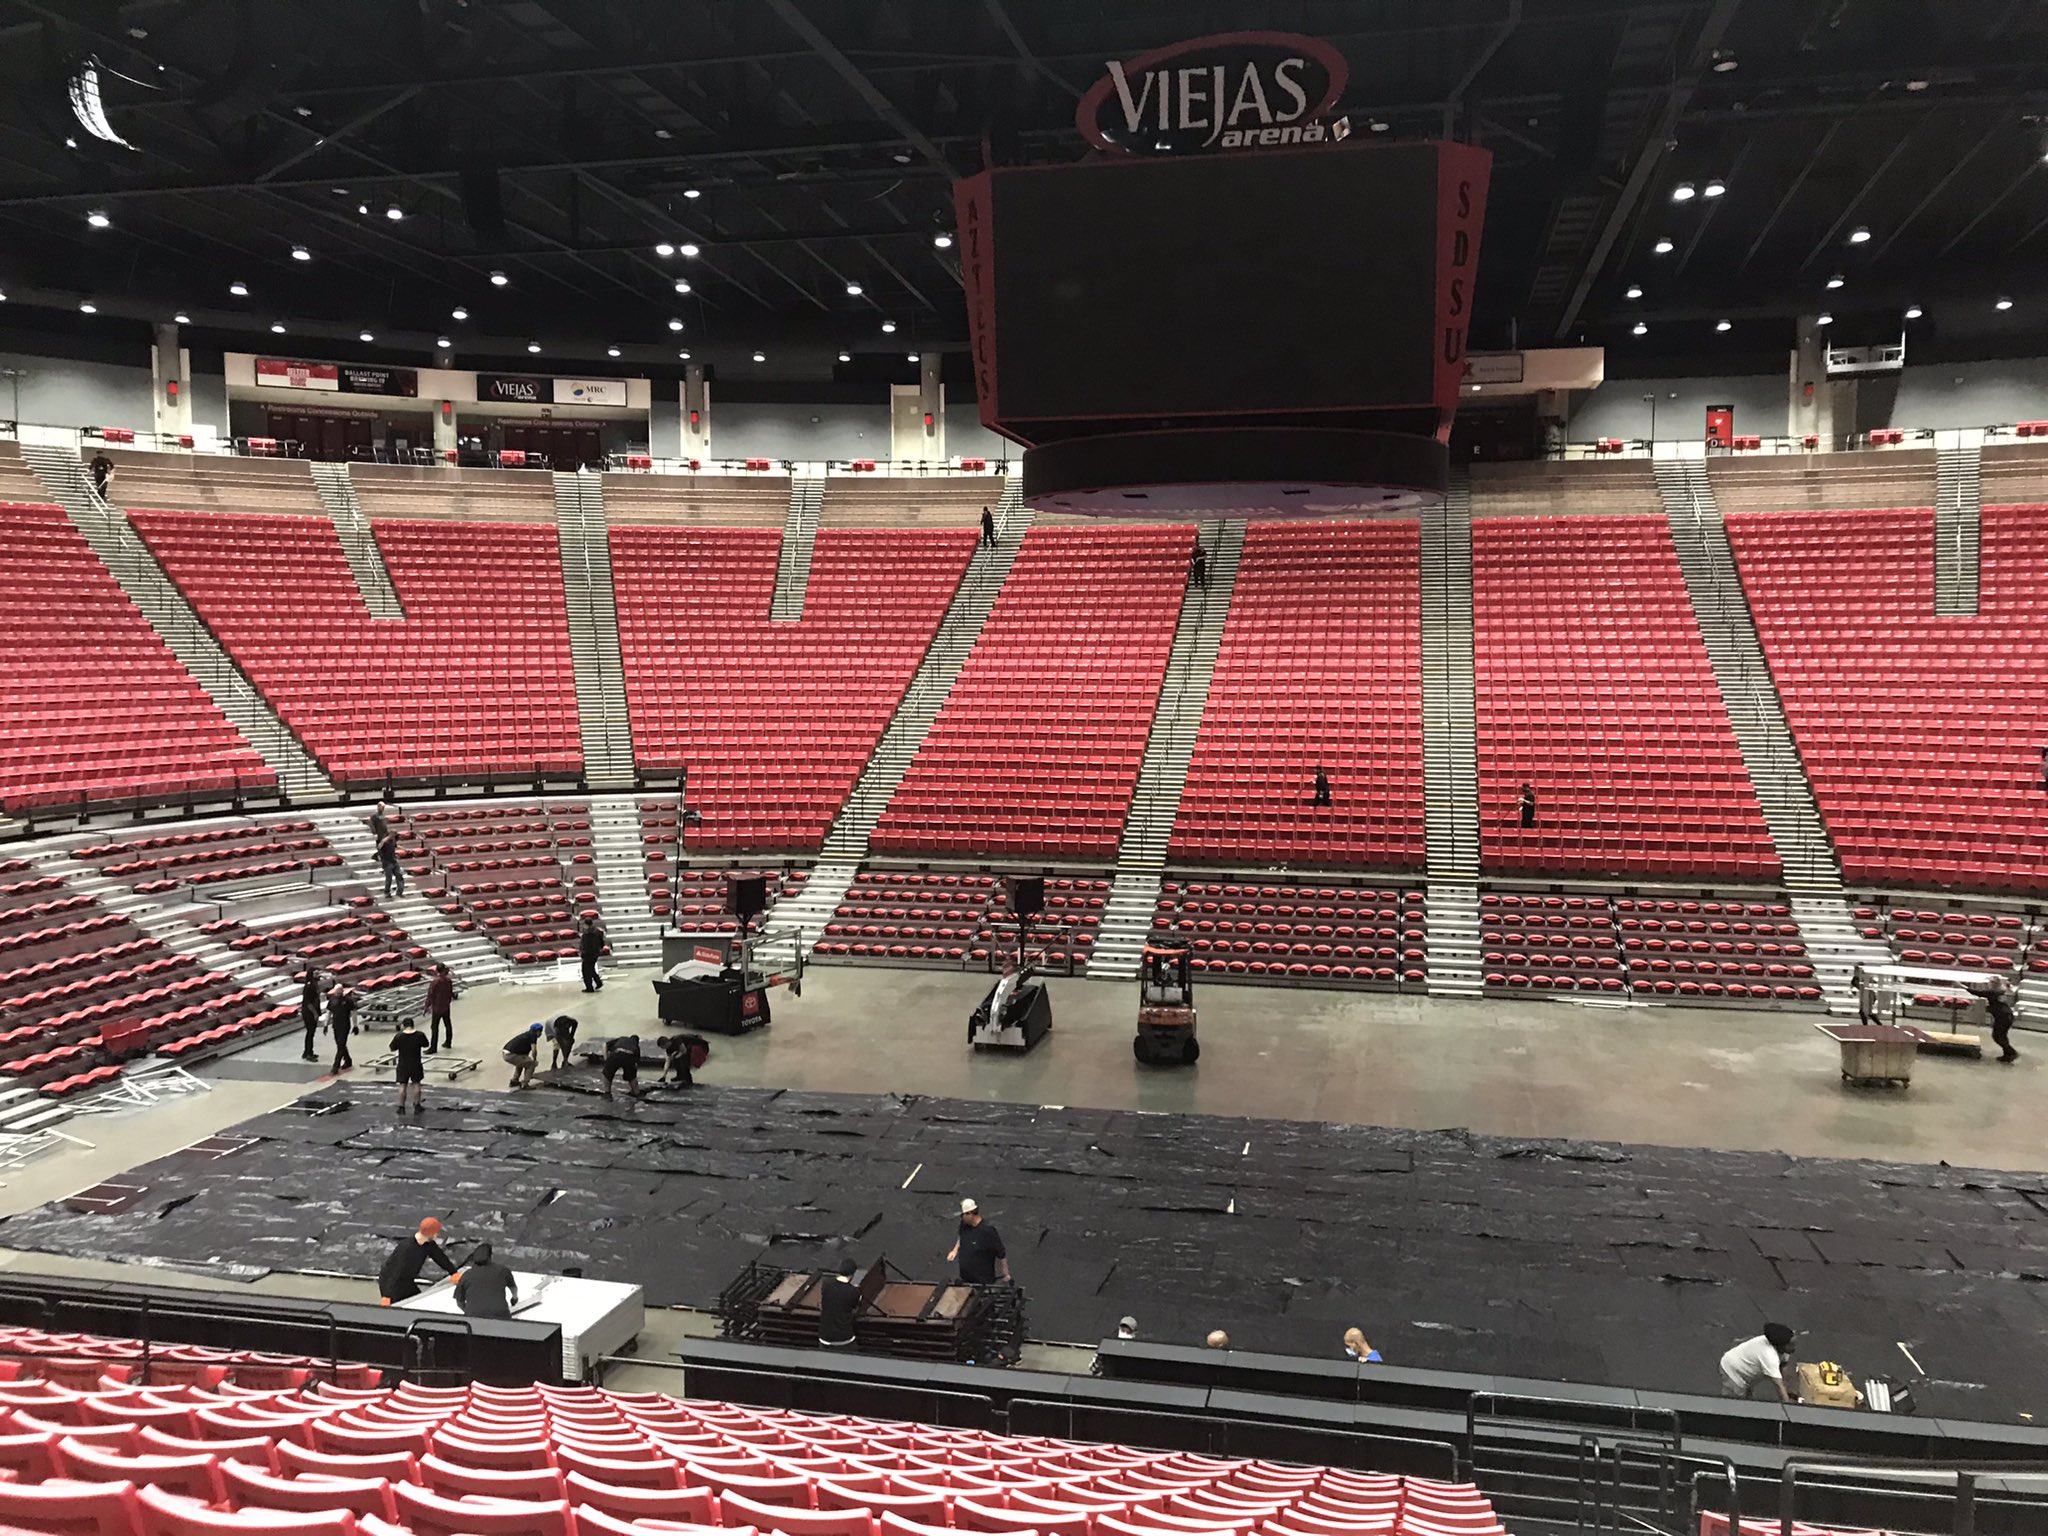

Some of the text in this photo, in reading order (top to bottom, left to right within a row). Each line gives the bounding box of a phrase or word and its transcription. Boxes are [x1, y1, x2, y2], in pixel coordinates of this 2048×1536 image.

[1105, 58, 1307, 148] VIEJAS
[1221, 123, 1325, 147] arena
[1444, 180, 1471, 364] SDSU
[344, 369, 390, 379] BALLAST POINT
[349, 376, 377, 384] BRING
[495, 380, 534, 399] VIEJAS
[586, 385, 607, 394] MRC
[352, 410, 378, 418] Outside
[742, 1016, 762, 1027] TOYOTA
